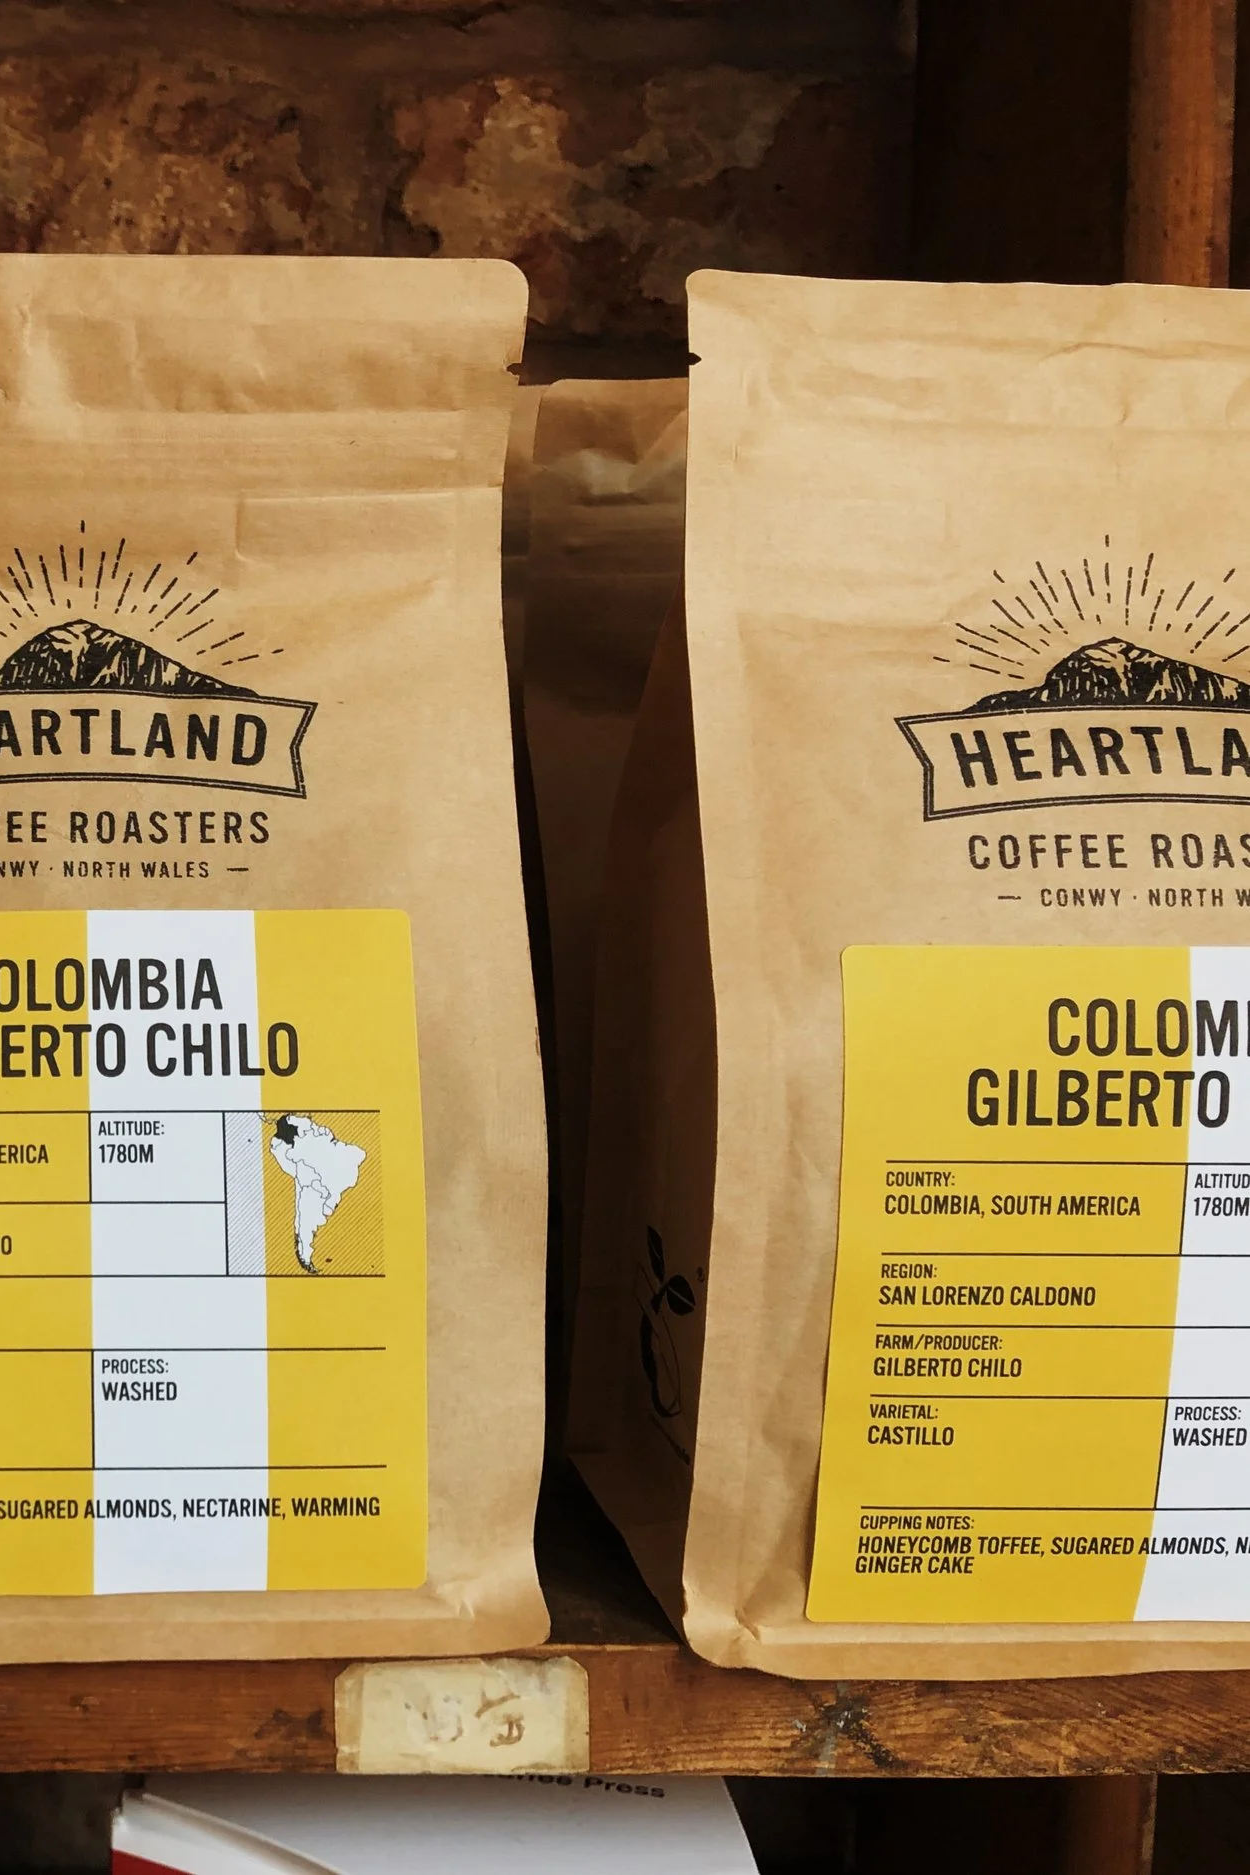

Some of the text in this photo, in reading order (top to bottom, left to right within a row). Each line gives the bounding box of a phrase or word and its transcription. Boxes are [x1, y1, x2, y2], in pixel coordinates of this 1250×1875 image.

[70, 811, 269, 844] ROASTERS
[969, 834, 1127, 869] COFFEE
[63, 861, 129, 878] NORTH
[141, 862, 209, 878] WALES
[1041, 888, 1120, 907] CONWY
[1149, 888, 1223, 907] NORTH
[1049, 998, 1250, 1057] COLOM
[147, 1022, 298, 1077] CHILO
[968, 1069, 1230, 1128] GILBERTO
[99, 1121, 164, 1136] ALTITUDE:
[99, 1144, 153, 1163] 1780M
[886, 1171, 954, 1187] COUNTRY:
[885, 1195, 1140, 1218] COLOMBIA, SOUTH AMERICA
[1194, 1197, 1250, 1216] 1780M
[881, 1264, 937, 1278] REGION:
[879, 1286, 1095, 1306] SAN LORENZO CALDONO
[876, 1334, 1002, 1350] FARM/PRODUCER:
[102, 1359, 168, 1374] PROCESS:
[874, 1357, 1022, 1377] GILBERTO CHILO
[102, 1381, 177, 1401] WASHED
[870, 1404, 938, 1419] VARIETAL:
[1175, 1406, 1241, 1421] PROCESS:
[868, 1425, 954, 1446] CASTILLO
[1173, 1428, 1247, 1446] WASHED
[84, 1499, 176, 1520] ALMONDS,
[183, 1498, 285, 1520] NECTARINE,
[292, 1497, 380, 1516] WARMING
[860, 1515, 974, 1530] CUPPING NOTES:
[858, 1536, 971, 1554] HONEYCOMB
[978, 1537, 1044, 1557] TOFFEE,
[1051, 1537, 1134, 1554] SUGARED
[1138, 1537, 1228, 1556] ALMONDS,
[856, 1556, 974, 1573] GINGER CAKE
[584, 1777, 665, 1798] Press
